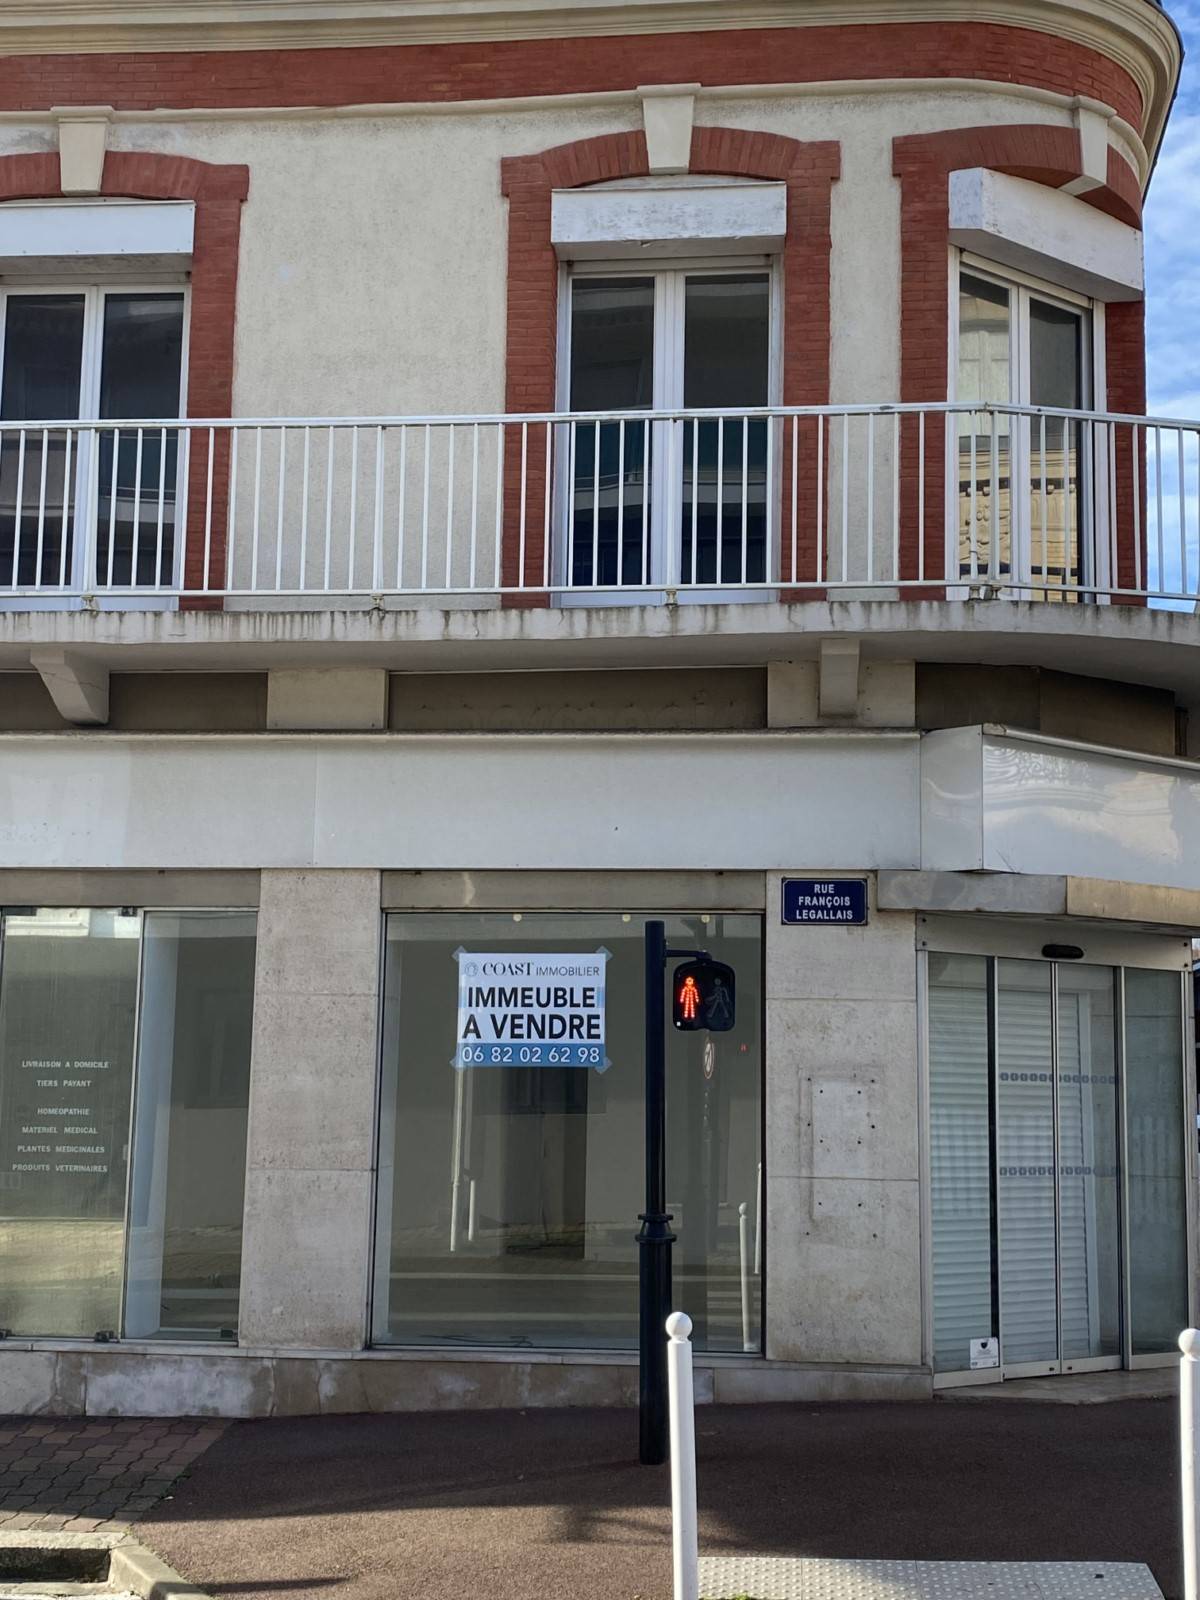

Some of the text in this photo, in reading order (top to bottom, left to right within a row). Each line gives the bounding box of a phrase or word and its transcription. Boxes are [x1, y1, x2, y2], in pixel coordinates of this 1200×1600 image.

[814, 884, 835, 893] RUE
[798, 896, 850, 908] FRANÇOIS
[796, 910, 853, 919] LEGALLAIS
[482, 962, 600, 976] COAST IMMOBILIER
[468, 987, 595, 1008] IMMEUBLE
[462, 1014, 601, 1039] A VENDRE
[462, 1047, 600, 1062] 06 82 02 62 98
[74, 1061, 109, 1069] DOMICILE
[22, 1126, 98, 1134] MATERIEL MEDICAL
[55, 1145, 105, 1153] MEDICINALES
[55, 1164, 108, 1172] VETERINAIRES
